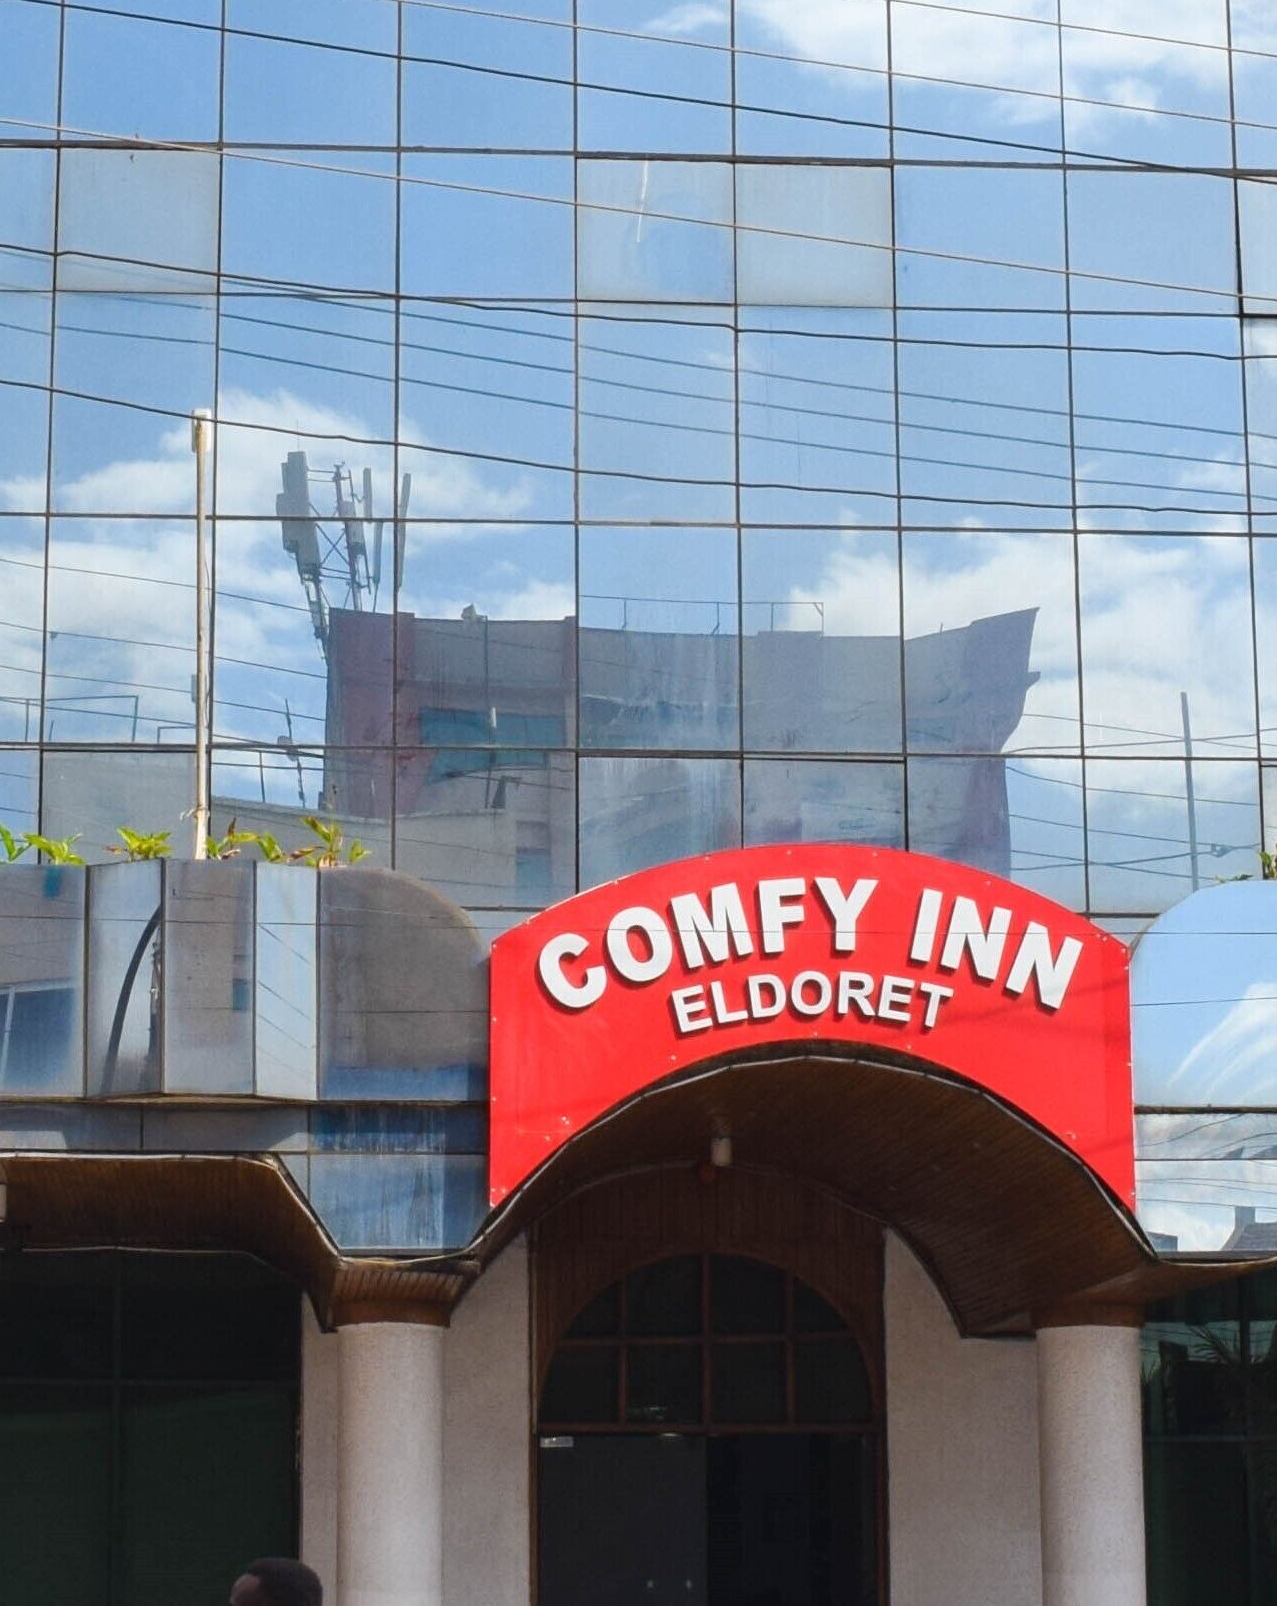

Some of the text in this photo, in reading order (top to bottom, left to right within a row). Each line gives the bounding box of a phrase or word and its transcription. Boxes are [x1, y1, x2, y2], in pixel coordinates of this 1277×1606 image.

[539, 877, 1083, 1010] COMFY INN
[671, 971, 954, 1034] ELDORET
